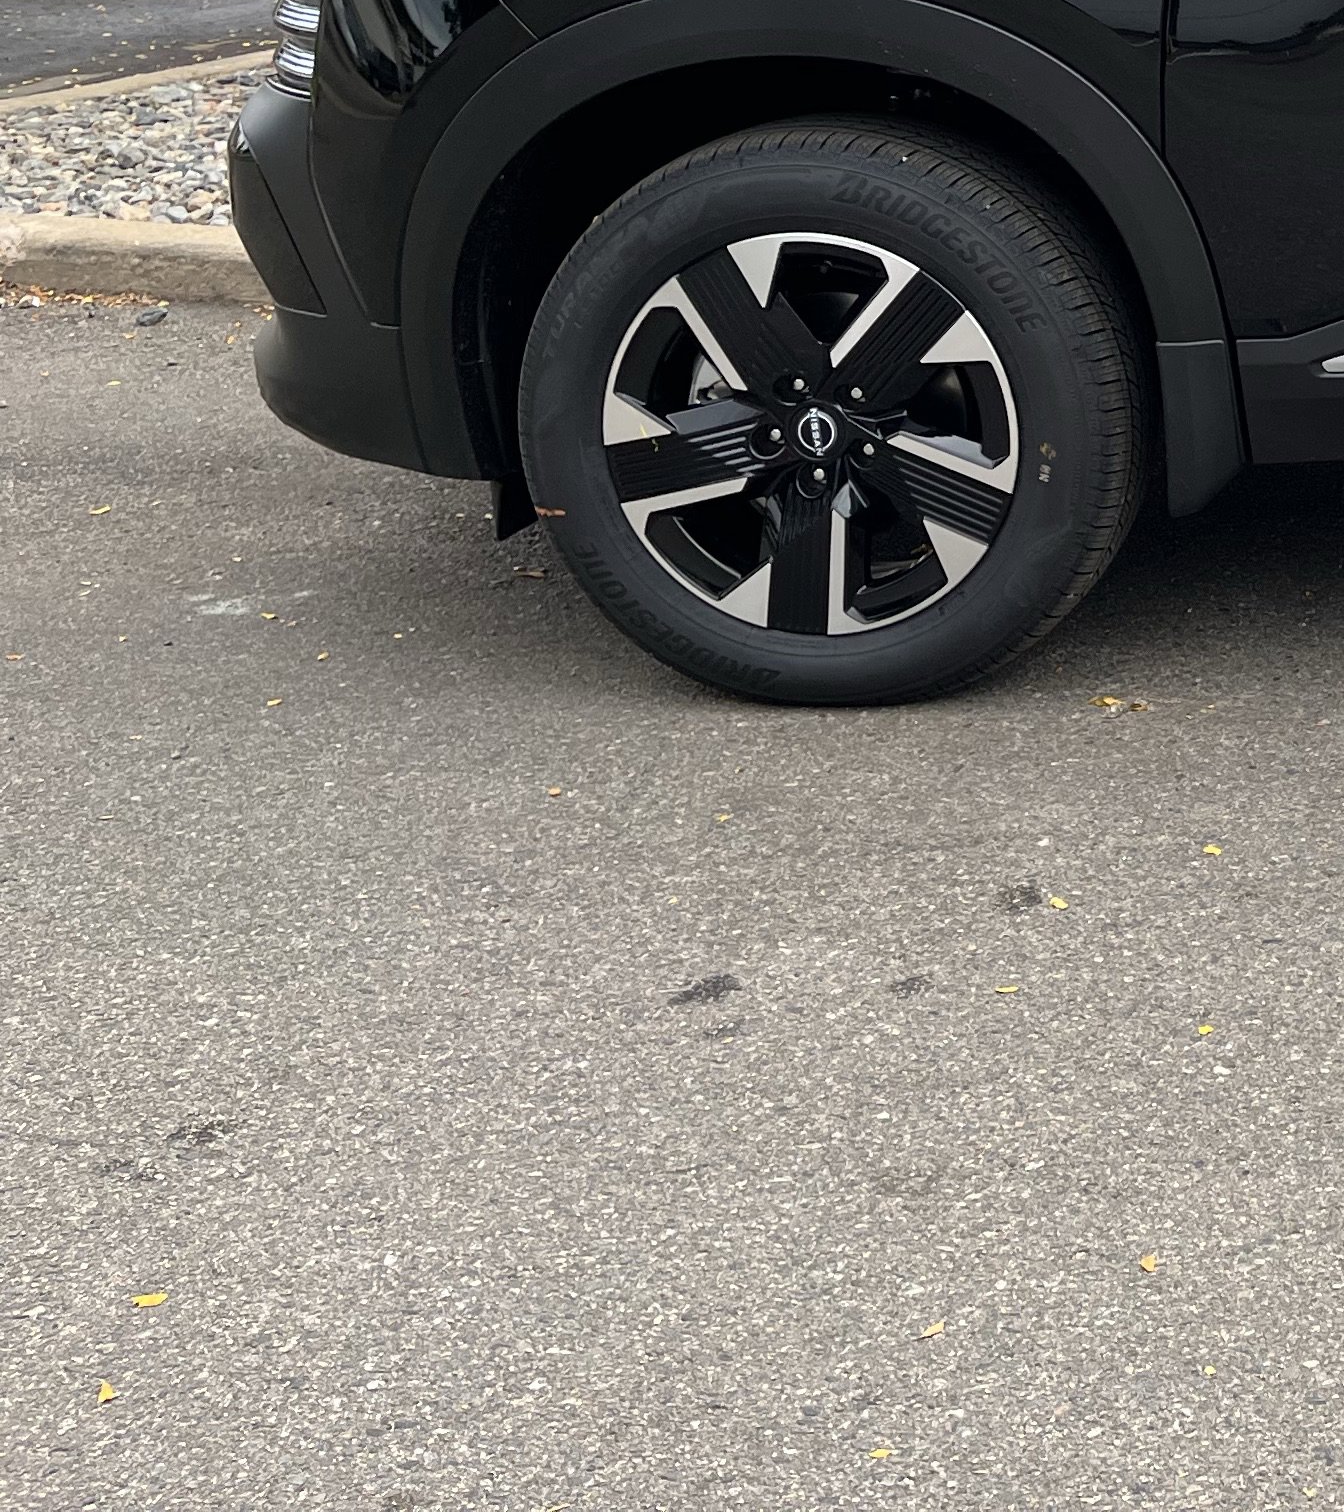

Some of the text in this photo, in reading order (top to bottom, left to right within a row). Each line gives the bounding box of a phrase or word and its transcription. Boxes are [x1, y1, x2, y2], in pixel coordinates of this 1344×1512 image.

[829, 172, 1048, 334] BRIDGESTONE
[809, 407, 824, 456] NISSAN
[573, 541, 782, 688] BRIDGESTONE
